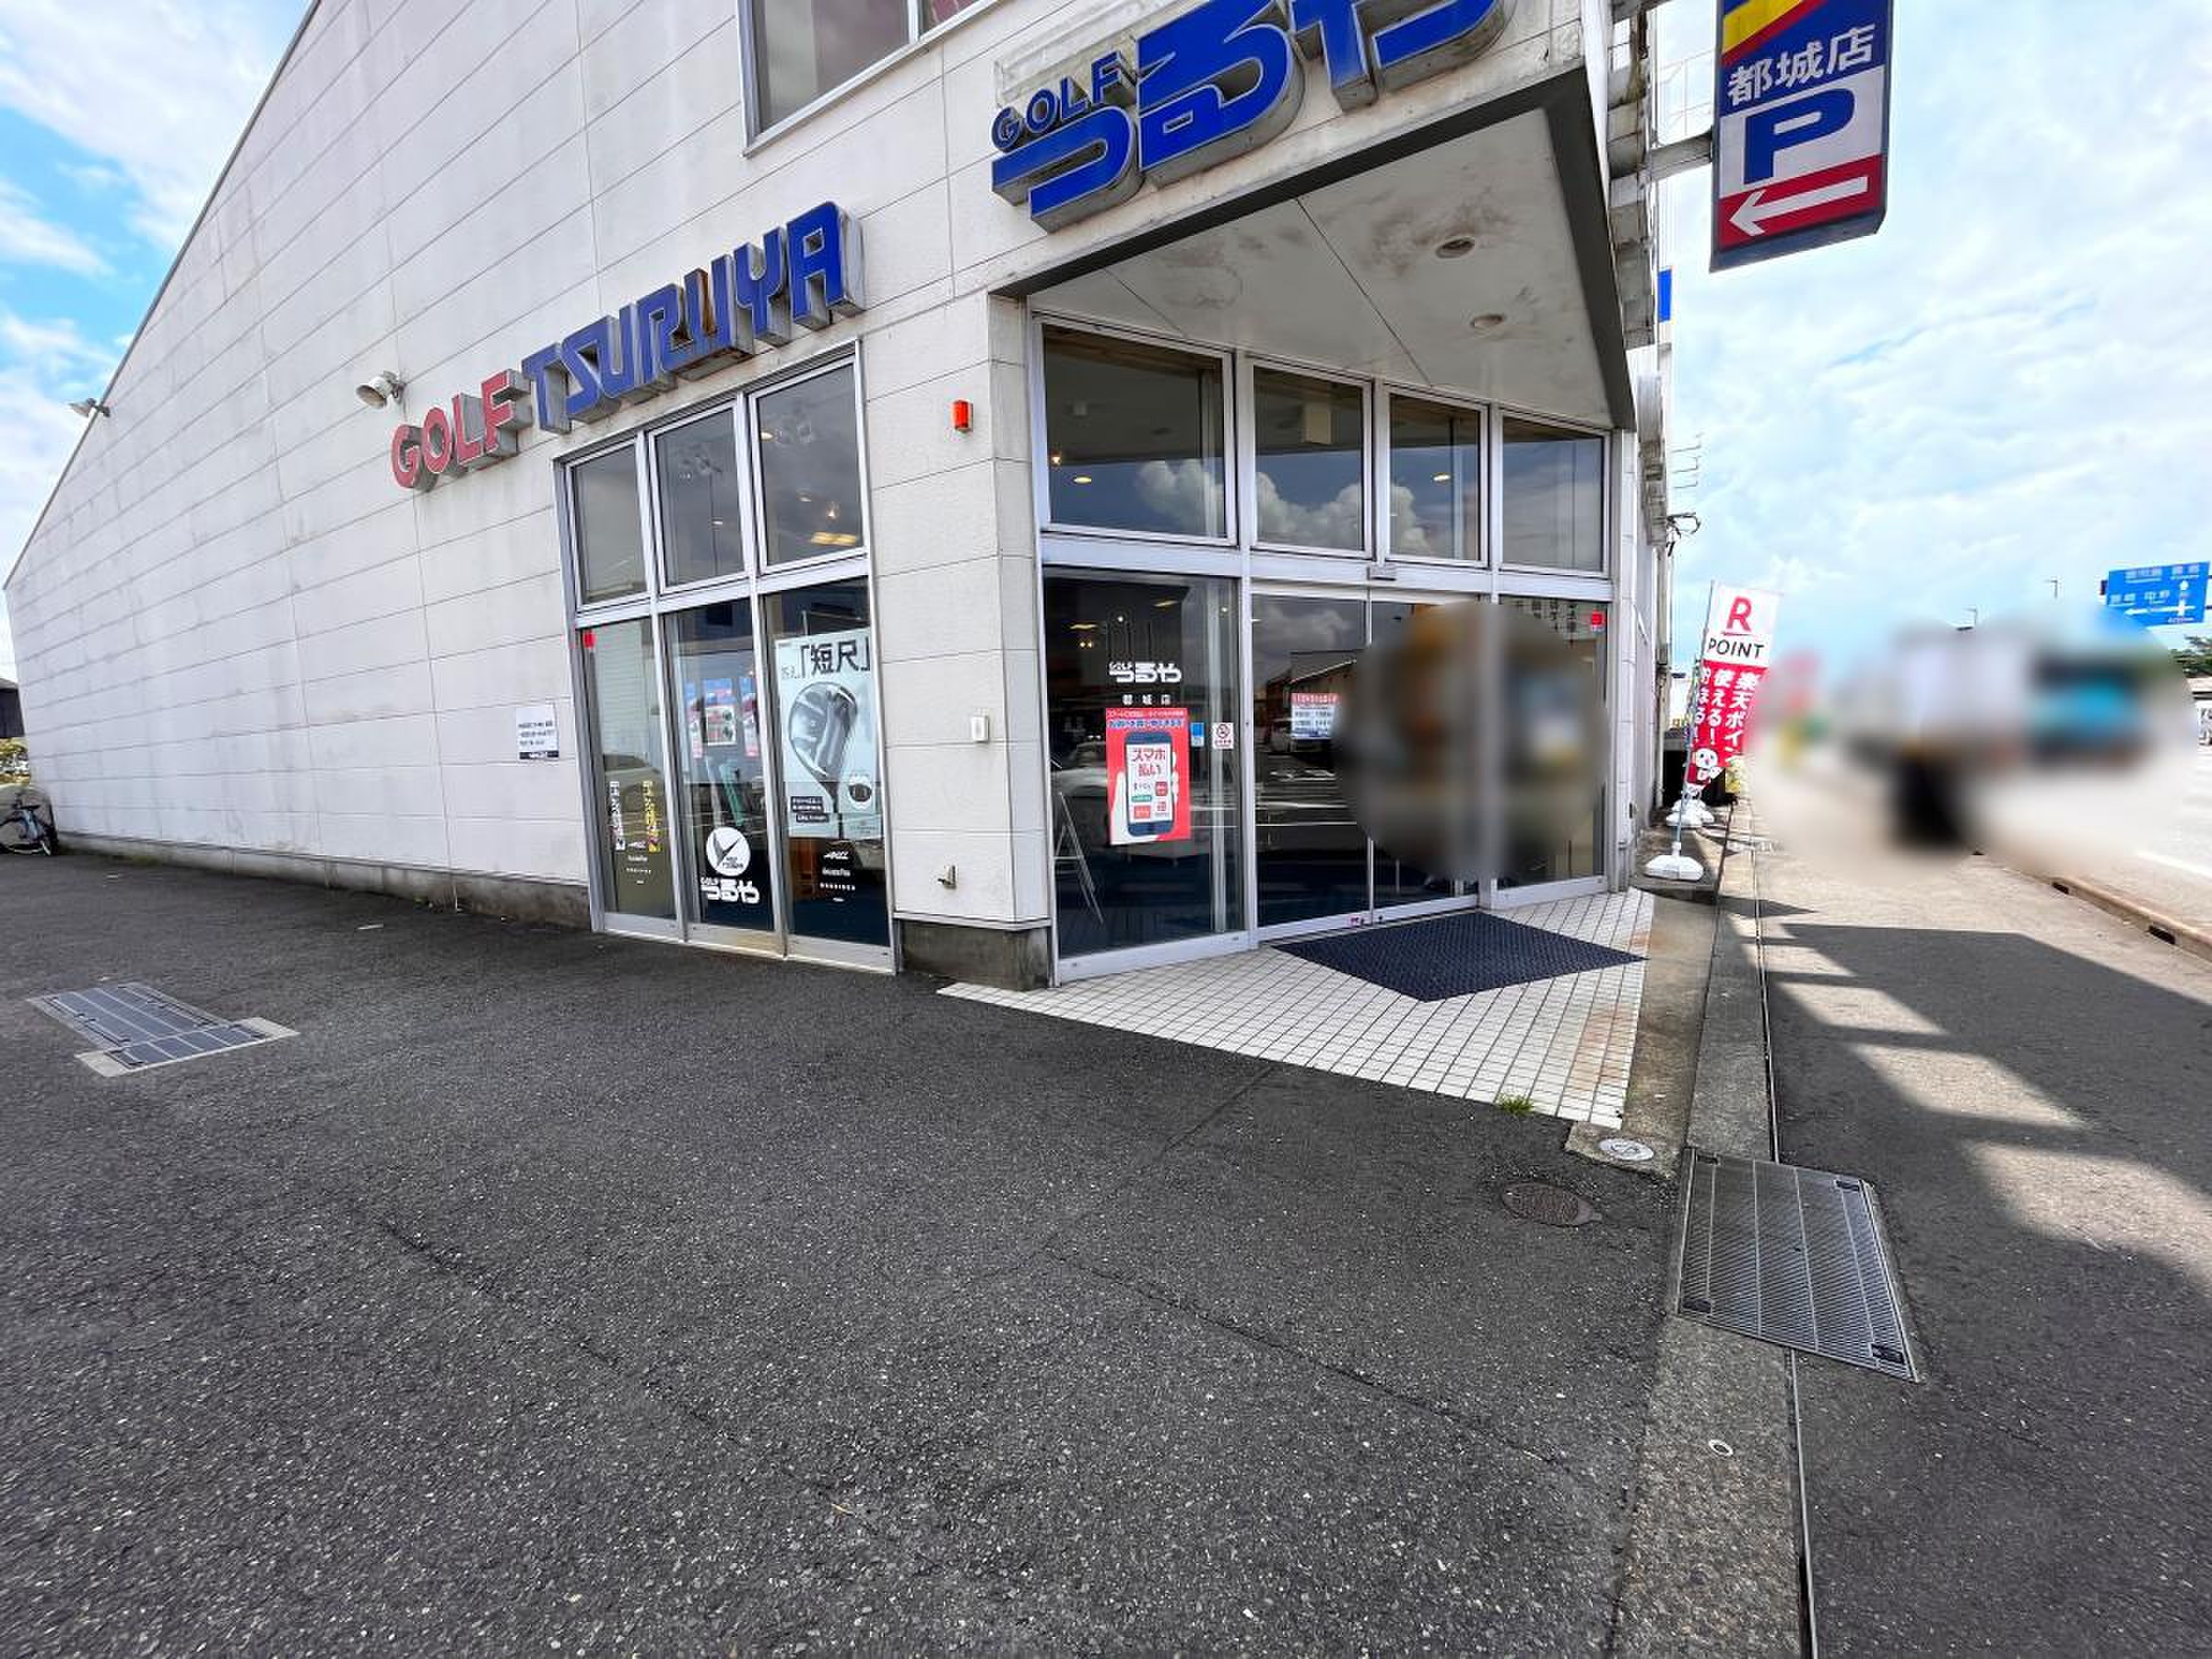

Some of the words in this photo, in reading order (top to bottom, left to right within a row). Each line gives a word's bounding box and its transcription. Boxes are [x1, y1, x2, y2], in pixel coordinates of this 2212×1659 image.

[991, 52, 1126, 151] GOLF
[1728, 23, 1876, 105] 都城店
[1743, 88, 1855, 184] P
[391, 369, 525, 492] GOLF
[521, 200, 855, 433] TSURUYA
[1708, 638, 1765, 659] POINT
[1725, 595, 1753, 636] R
[1132, 747, 1167, 763] スマホ
